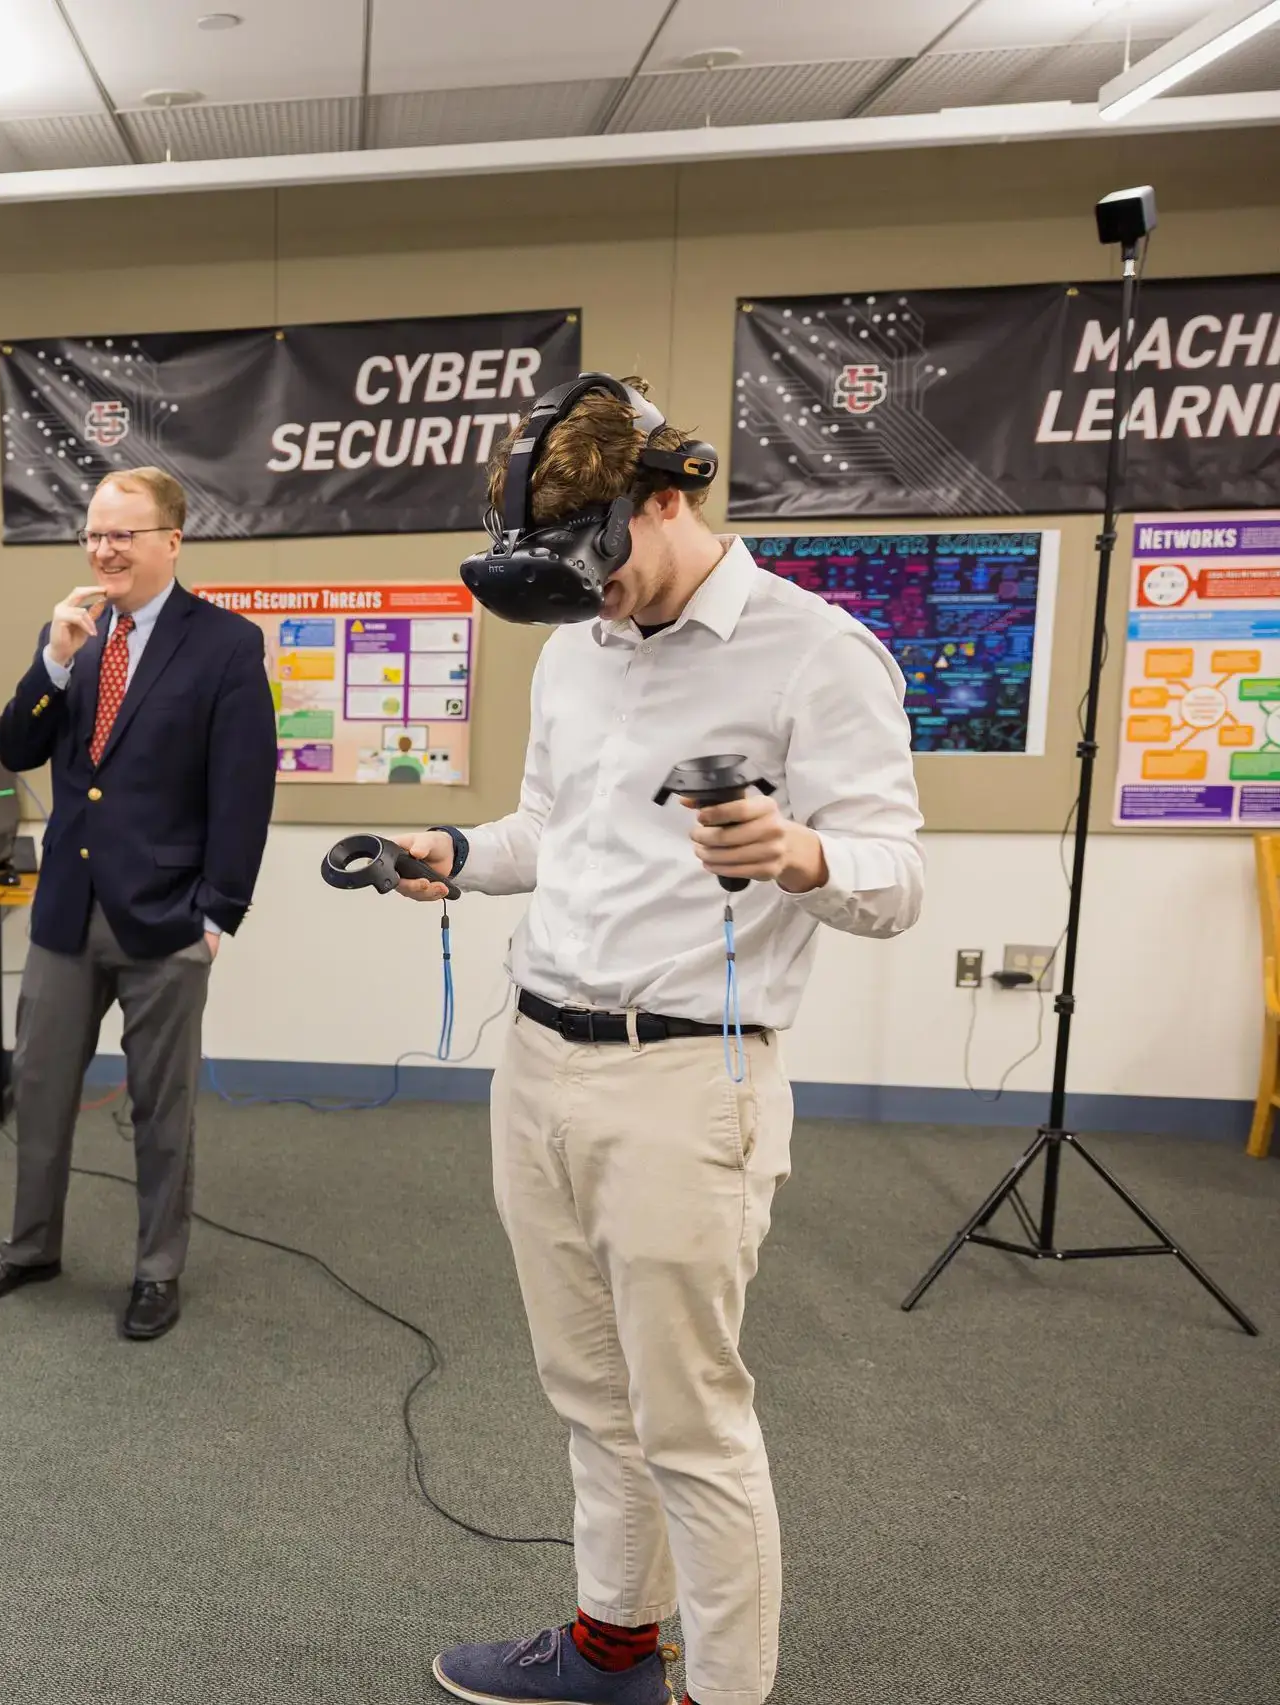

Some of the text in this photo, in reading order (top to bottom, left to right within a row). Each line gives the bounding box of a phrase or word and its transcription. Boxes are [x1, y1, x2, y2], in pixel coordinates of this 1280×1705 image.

[355, 347, 542, 406] CYBER
[266, 413, 521, 472] SECURIT
[793, 535, 929, 556] COMPUTER
[935, 533, 1037, 555] SCIENCE
[1139, 527, 1238, 550] NETWORKS
[254, 590, 320, 610] SECURITY
[321, 589, 382, 609] THREATS
